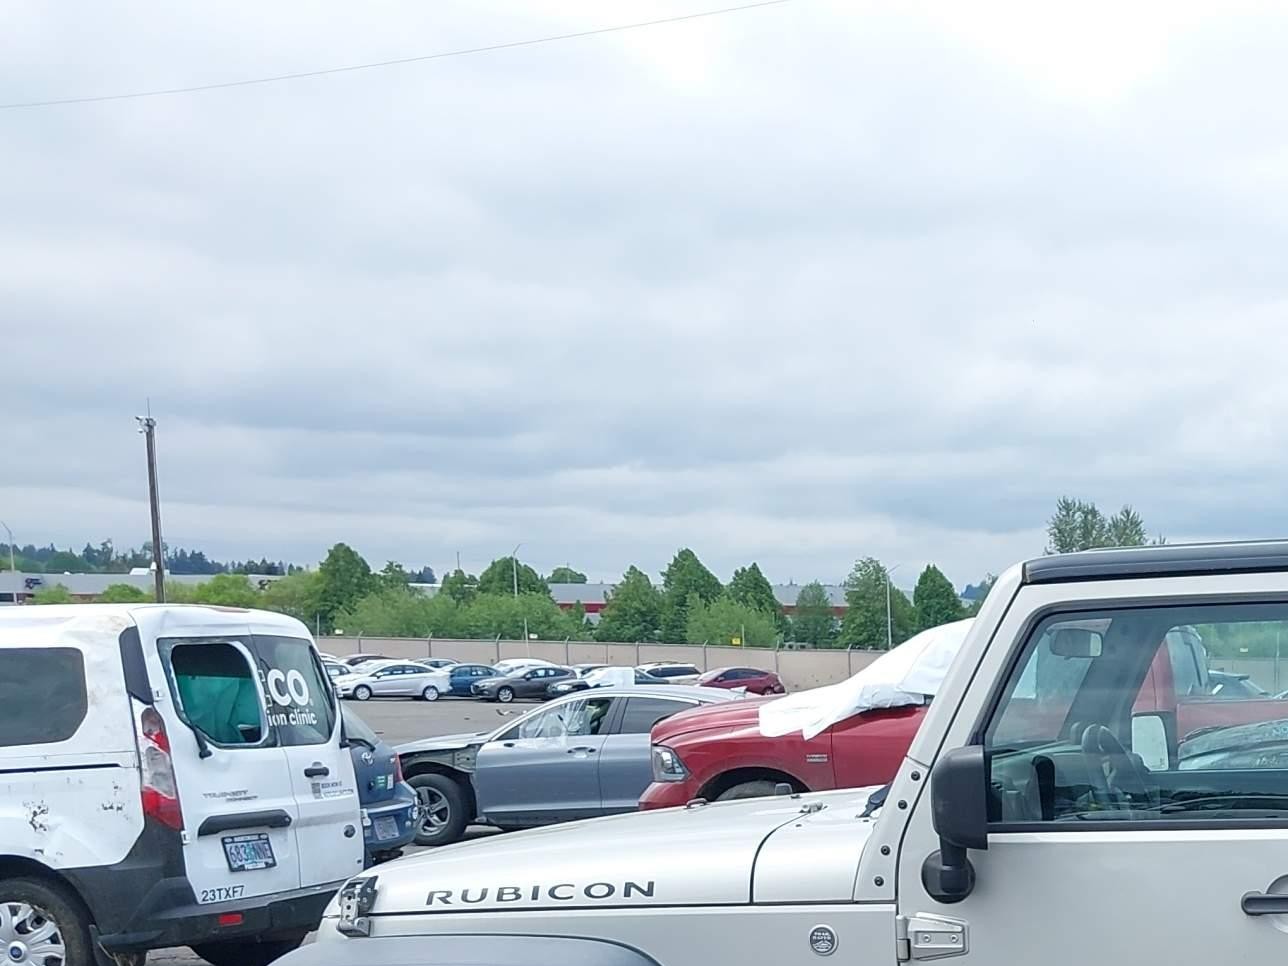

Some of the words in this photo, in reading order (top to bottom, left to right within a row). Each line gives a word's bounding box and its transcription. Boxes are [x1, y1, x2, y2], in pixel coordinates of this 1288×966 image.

[289, 708, 318, 725] clinic
[201, 884, 245, 902] 23TXF7
[425, 880, 655, 906] RUBICON
